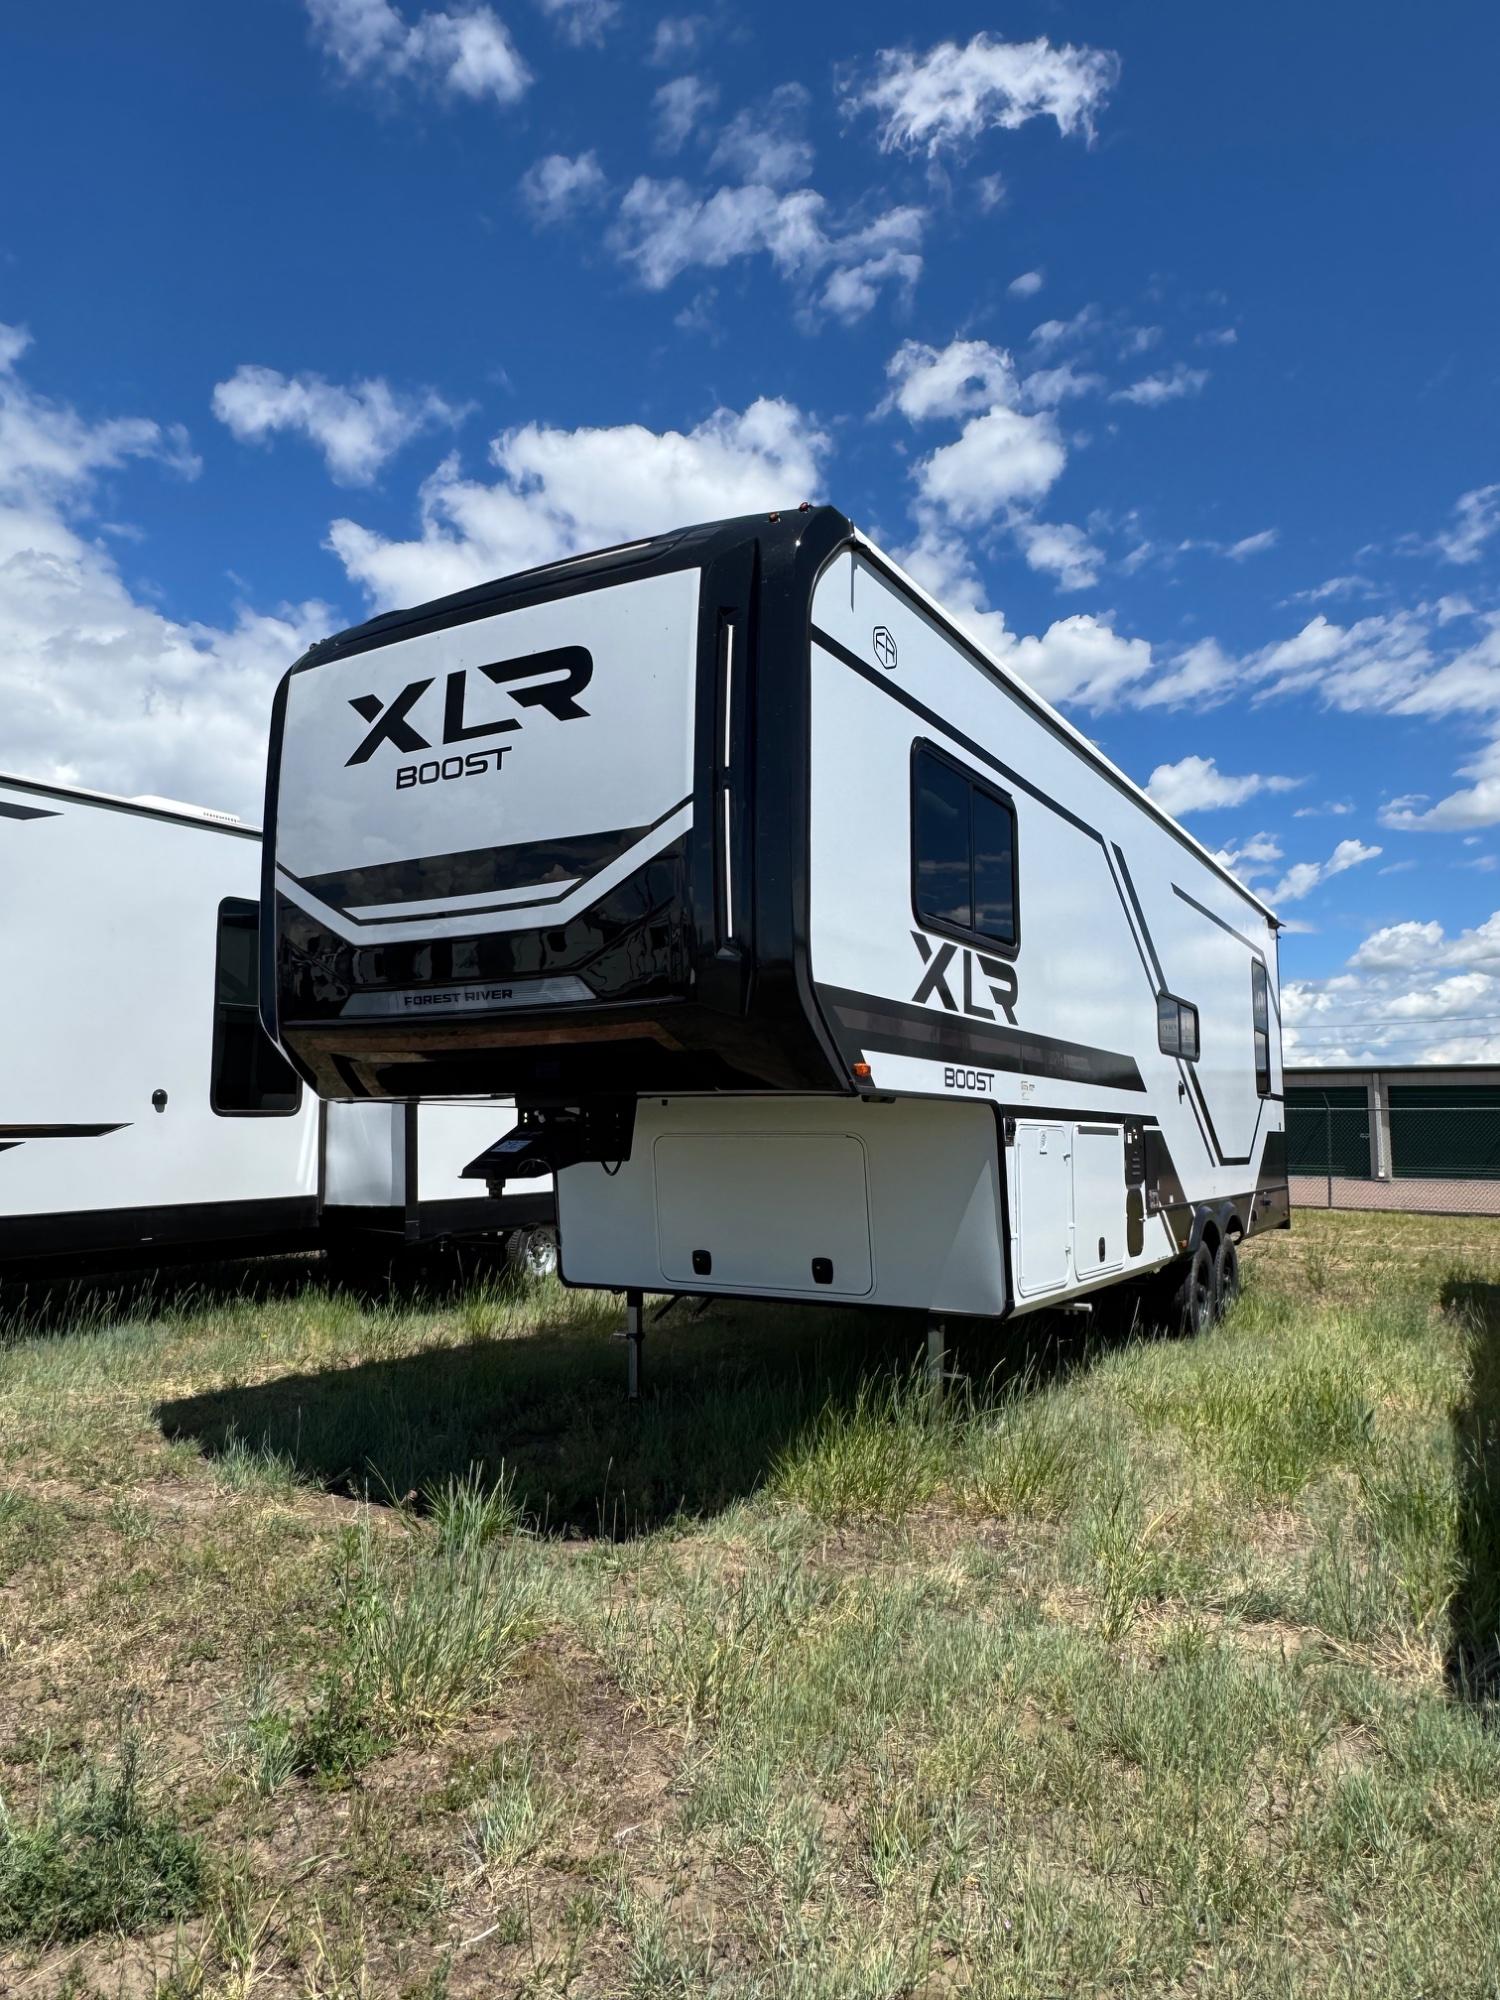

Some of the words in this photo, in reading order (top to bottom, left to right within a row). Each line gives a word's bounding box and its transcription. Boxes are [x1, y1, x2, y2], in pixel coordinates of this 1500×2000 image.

[344, 645, 593, 767] XLR
[396, 746, 512, 790] BOOST
[404, 992, 461, 1006] FOREST
[465, 989, 513, 1001] RIVER
[910, 930, 1019, 1026] XLR
[944, 1067, 995, 1092] BOOST
